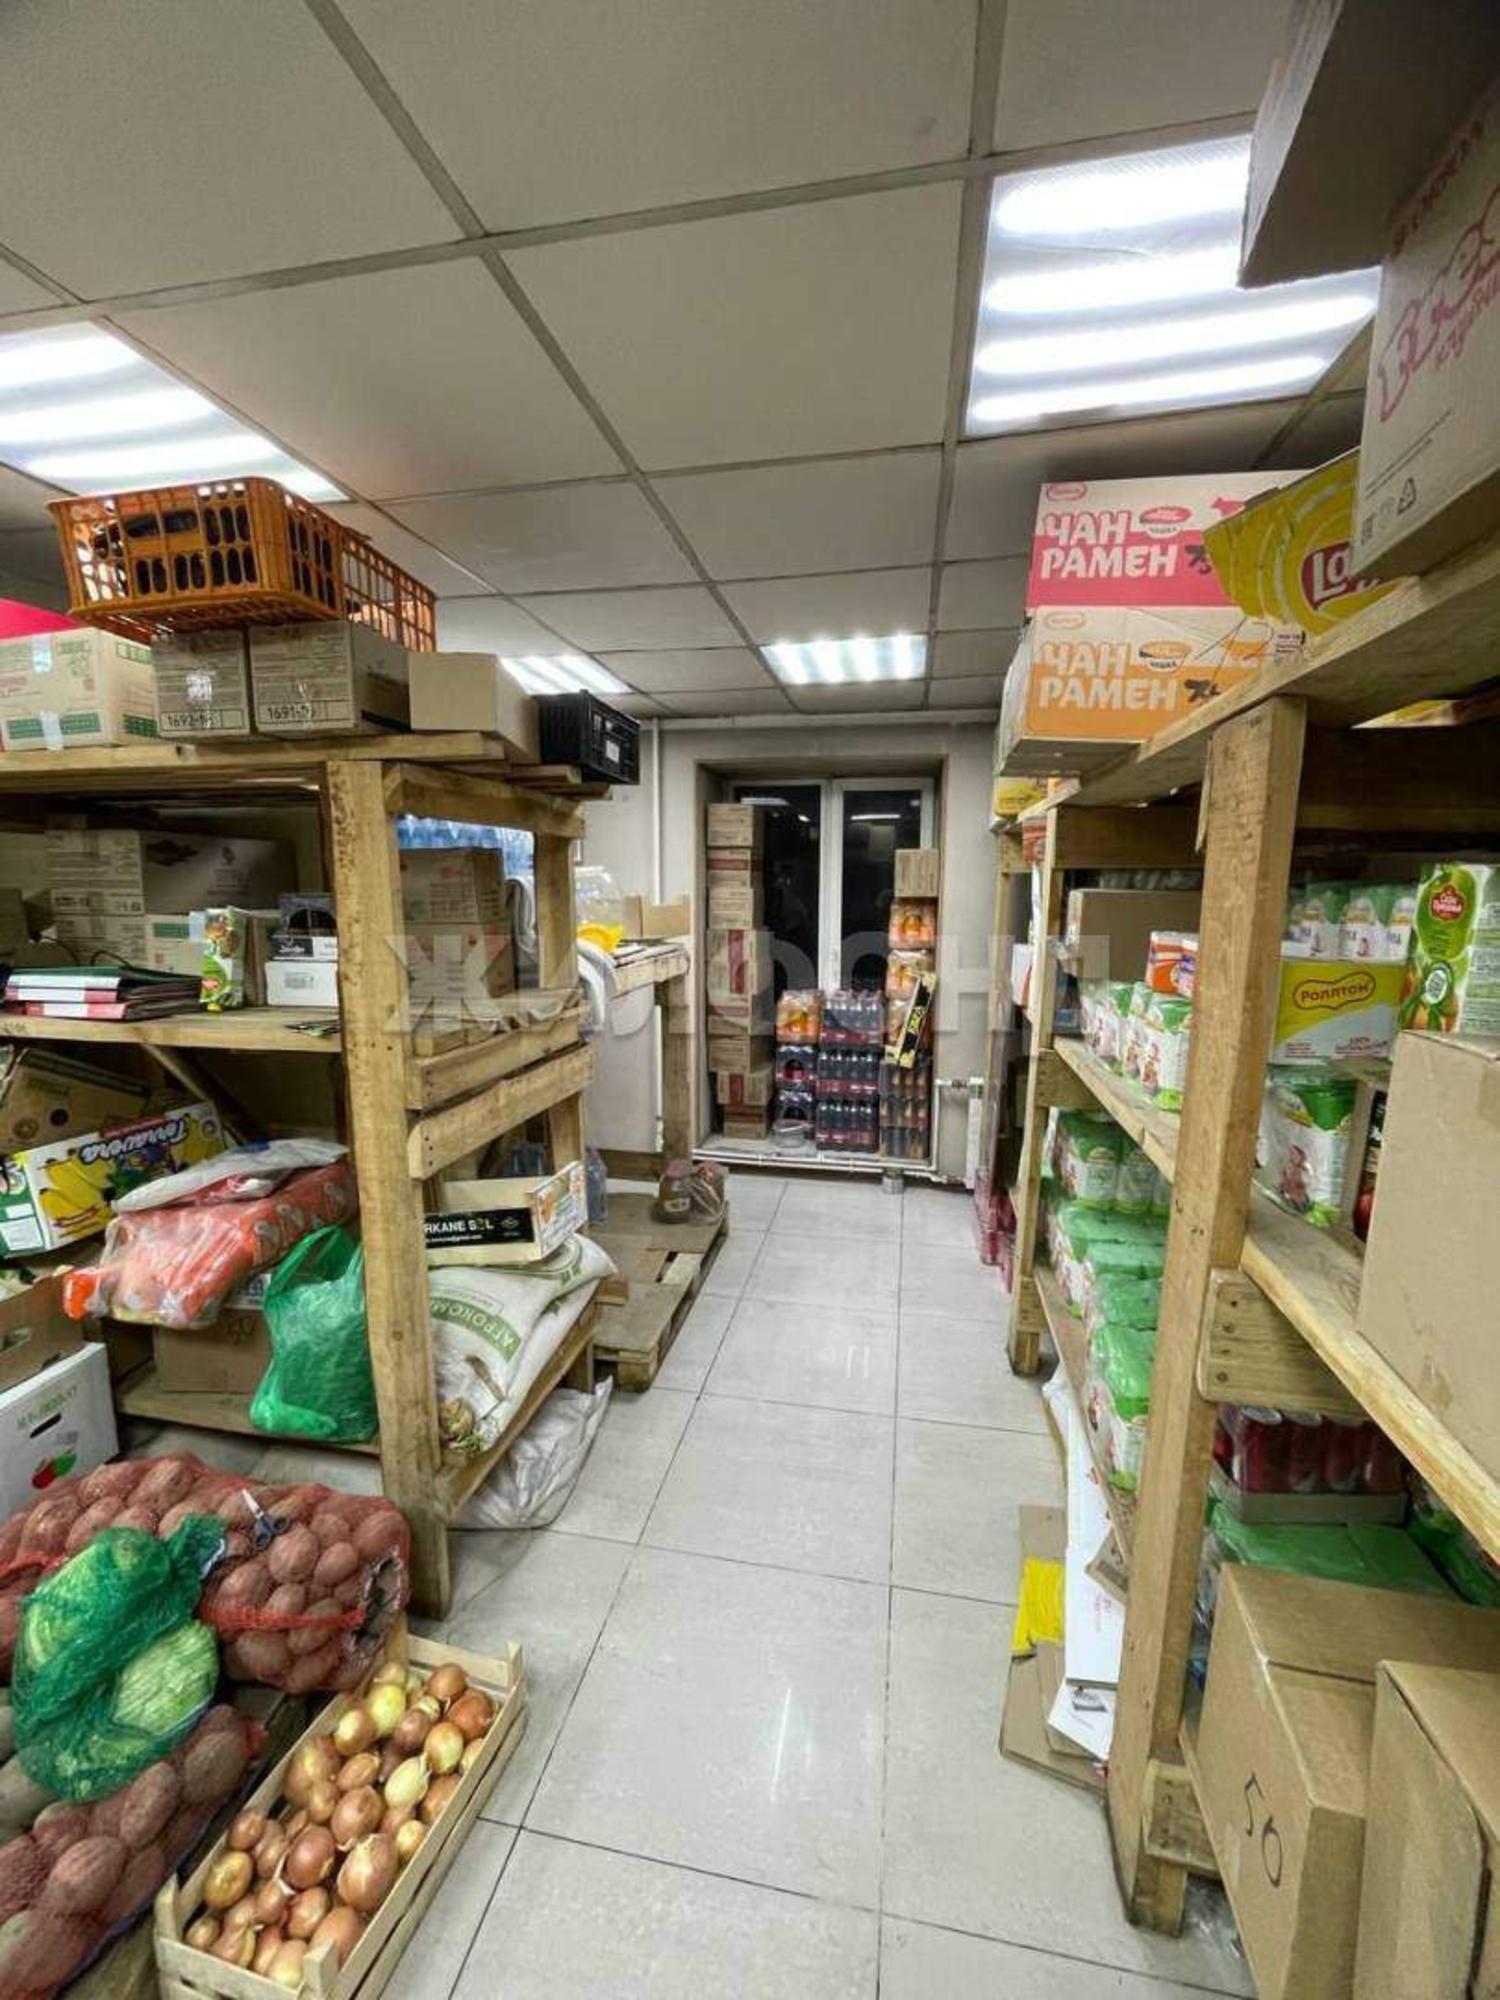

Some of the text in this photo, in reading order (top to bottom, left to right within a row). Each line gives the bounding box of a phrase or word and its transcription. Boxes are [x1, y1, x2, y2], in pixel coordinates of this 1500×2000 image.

[1043, 511, 1131, 545] ЧАН
[1041, 544, 1179, 579] РАМЕН
[1041, 641, 1130, 677] ЧАН
[1039, 676, 1178, 711] РАМЕН
